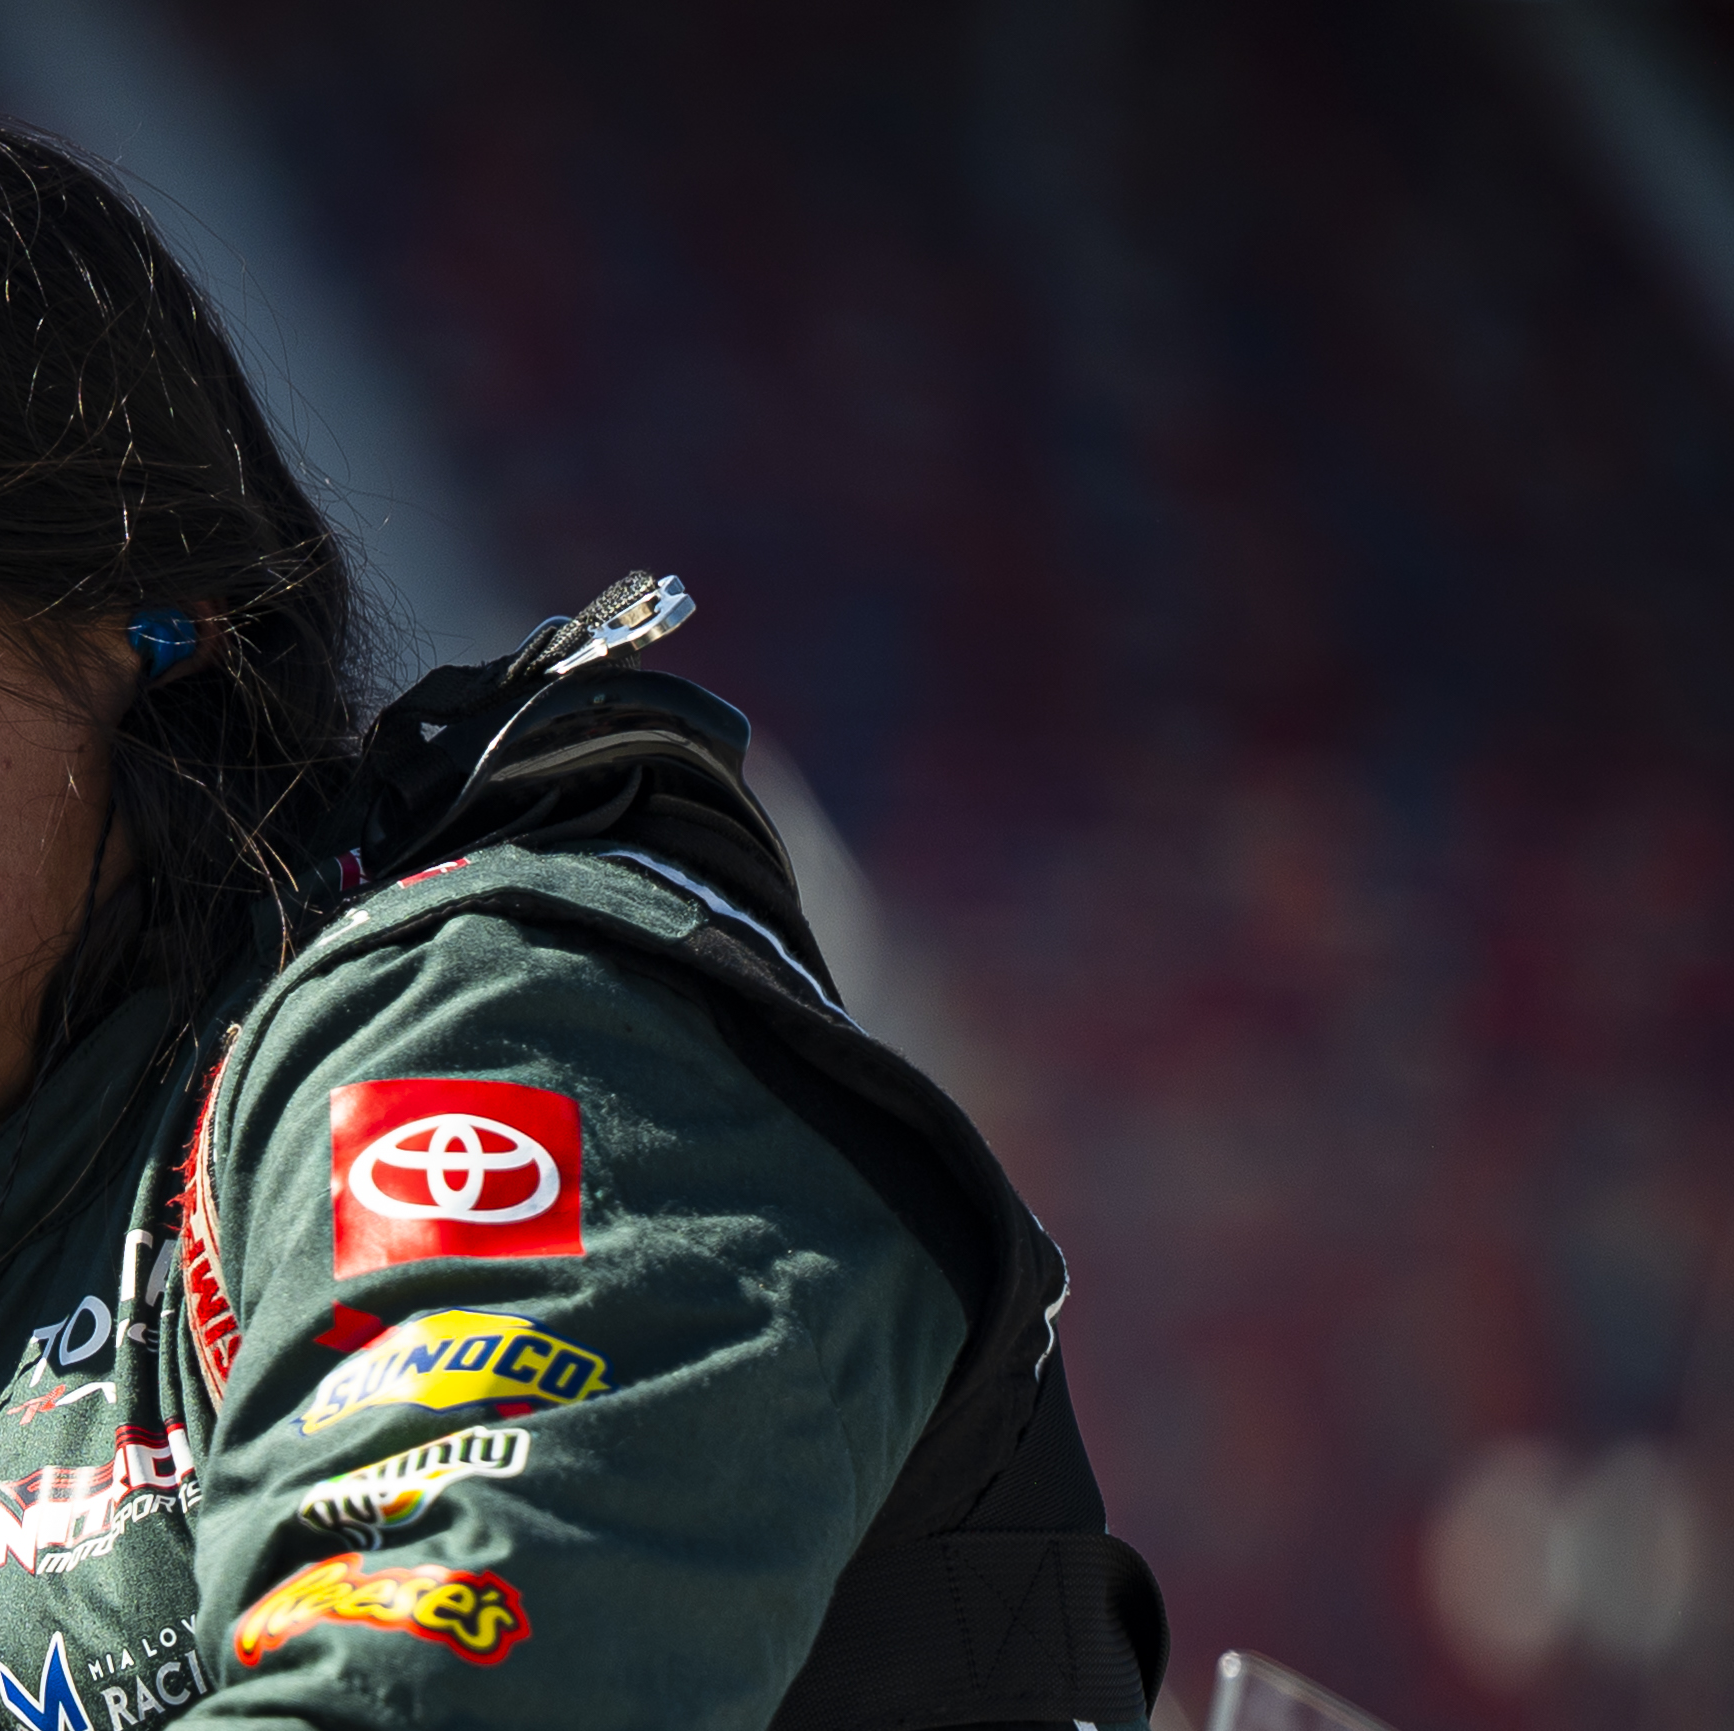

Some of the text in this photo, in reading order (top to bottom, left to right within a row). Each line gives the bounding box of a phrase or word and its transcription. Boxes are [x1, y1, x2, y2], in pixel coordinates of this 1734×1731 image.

[327, 1334, 598, 1420] SUNOCO
[301, 1433, 519, 1546] Bunty
[242, 1562, 514, 1653] Reese's
[87, 1648, 135, 1681] MIA
